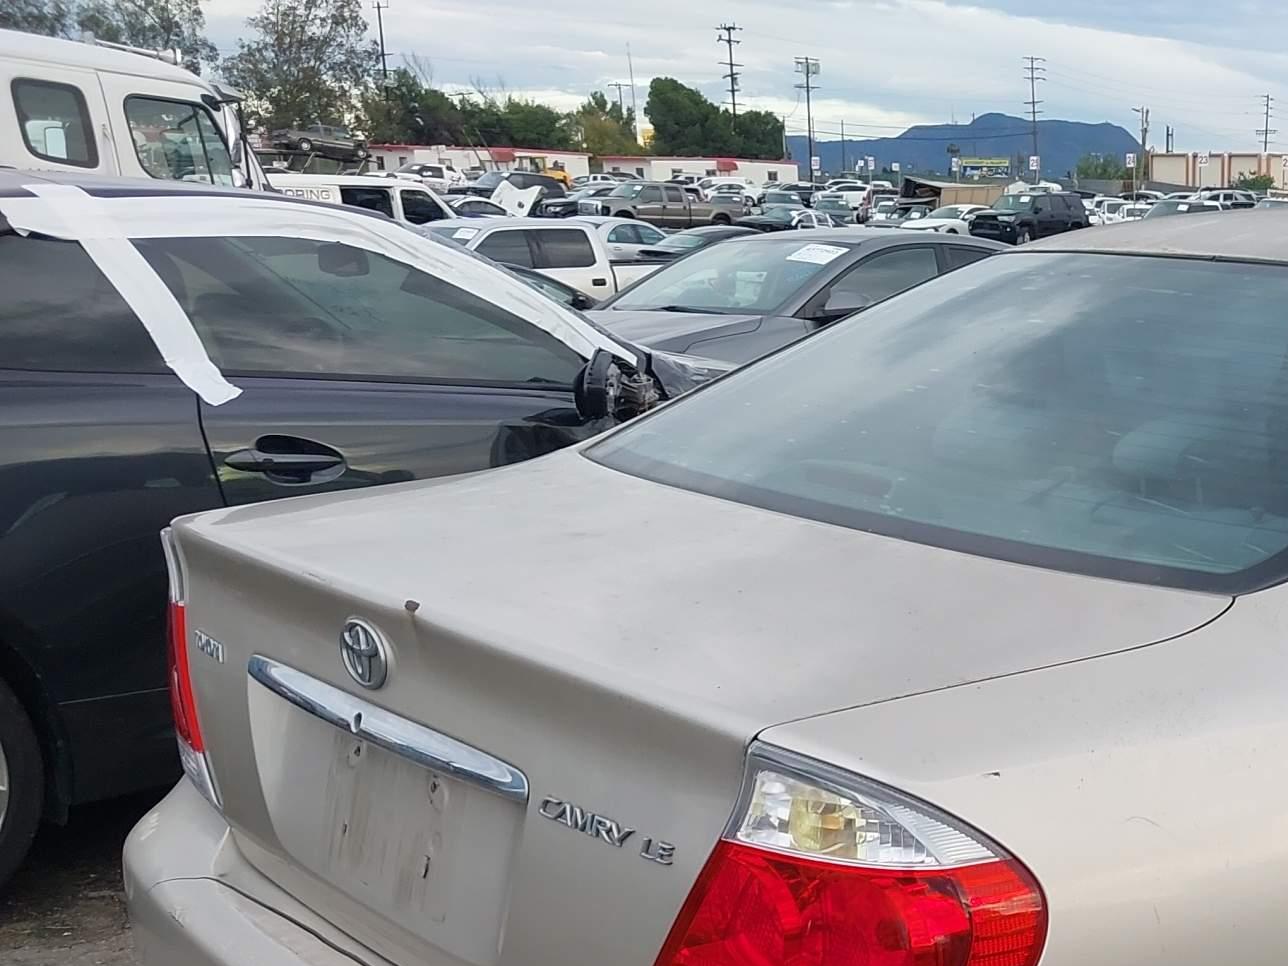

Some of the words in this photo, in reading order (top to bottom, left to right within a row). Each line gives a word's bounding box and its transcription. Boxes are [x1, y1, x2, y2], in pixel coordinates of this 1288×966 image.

[1199, 156, 1208, 164] 23
[539, 795, 636, 848] CAMRY
[640, 838, 676, 866] LE
